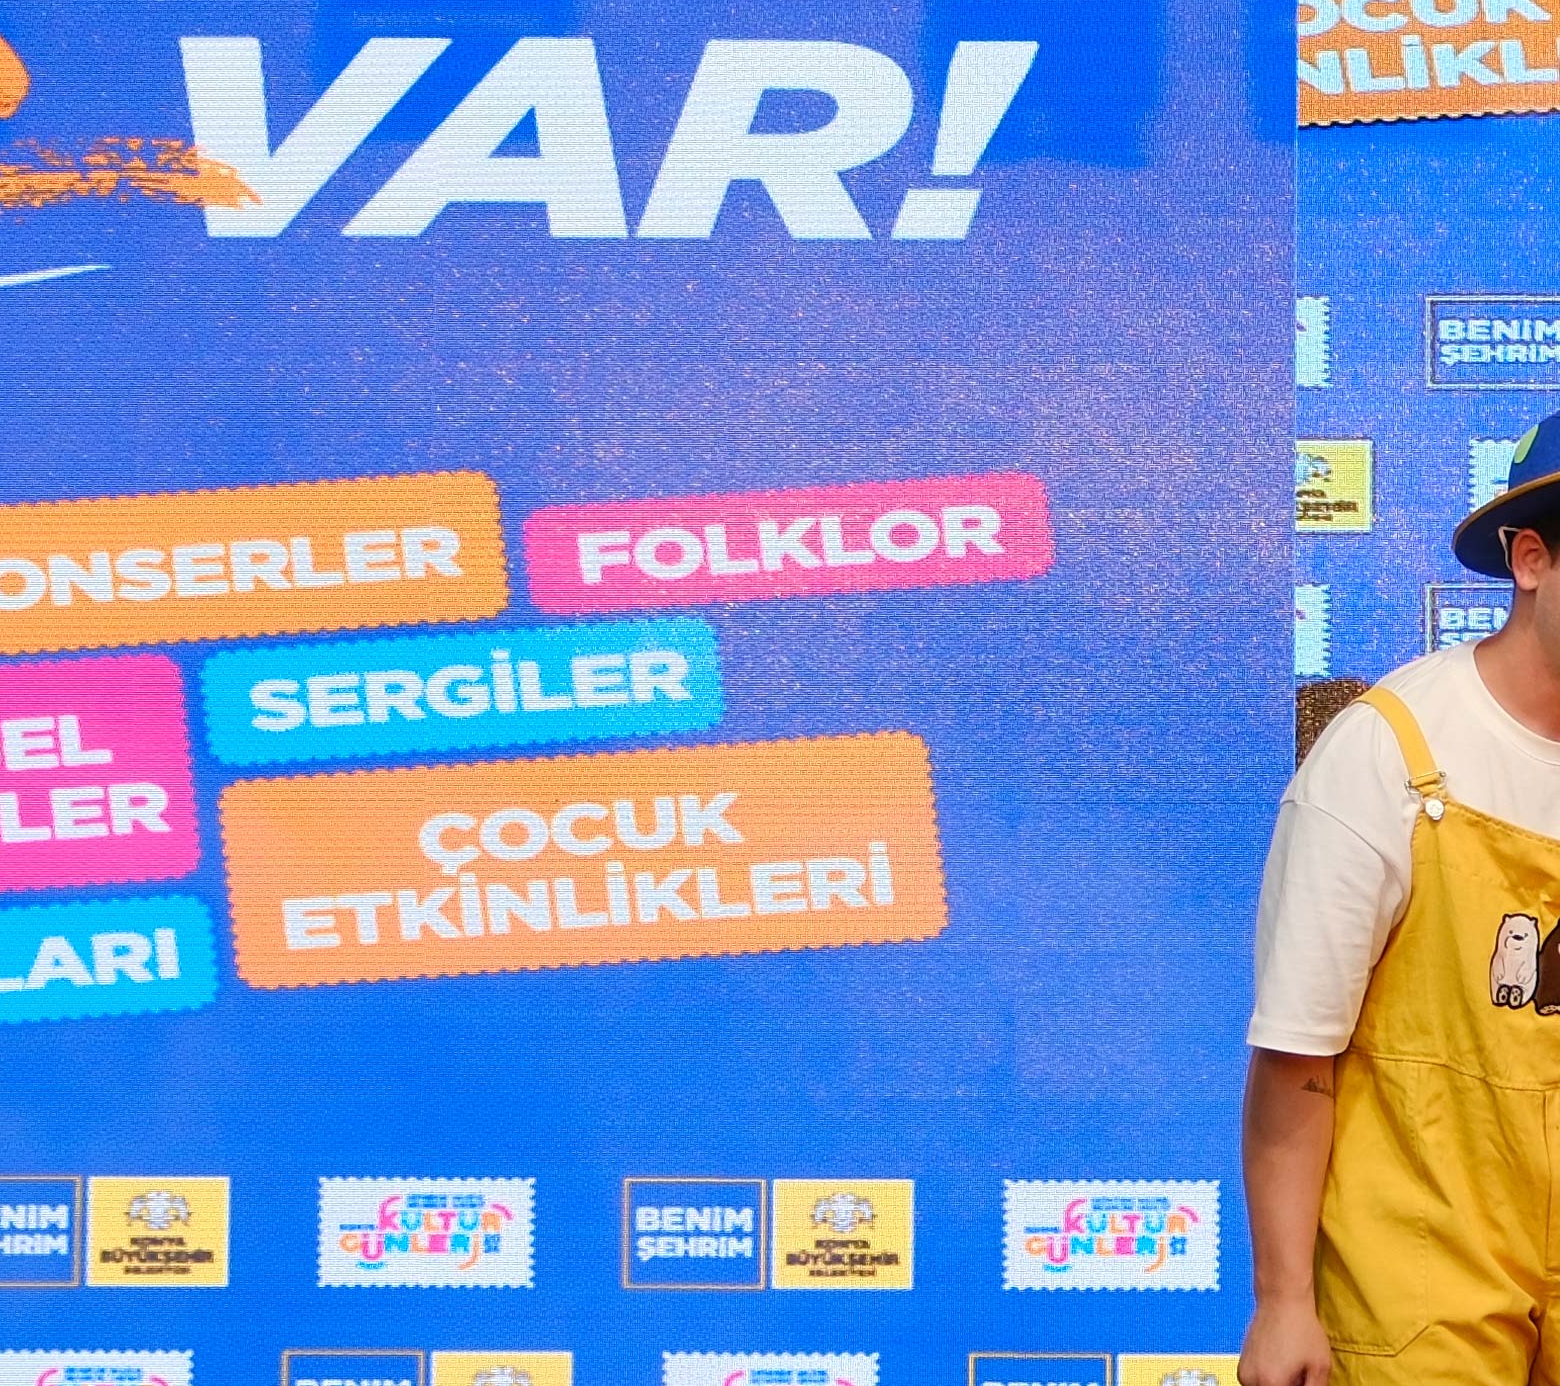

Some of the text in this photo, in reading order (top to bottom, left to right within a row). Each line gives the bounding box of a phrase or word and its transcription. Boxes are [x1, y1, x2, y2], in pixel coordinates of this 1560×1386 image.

[180, 35, 1039, 241] VAR!
[575, 499, 1006, 587] FOLKLOR
[249, 645, 693, 732] SERGİLER
[417, 790, 742, 876] ÇOCUK
[279, 837, 898, 954] ETKİNLİKLERİ
